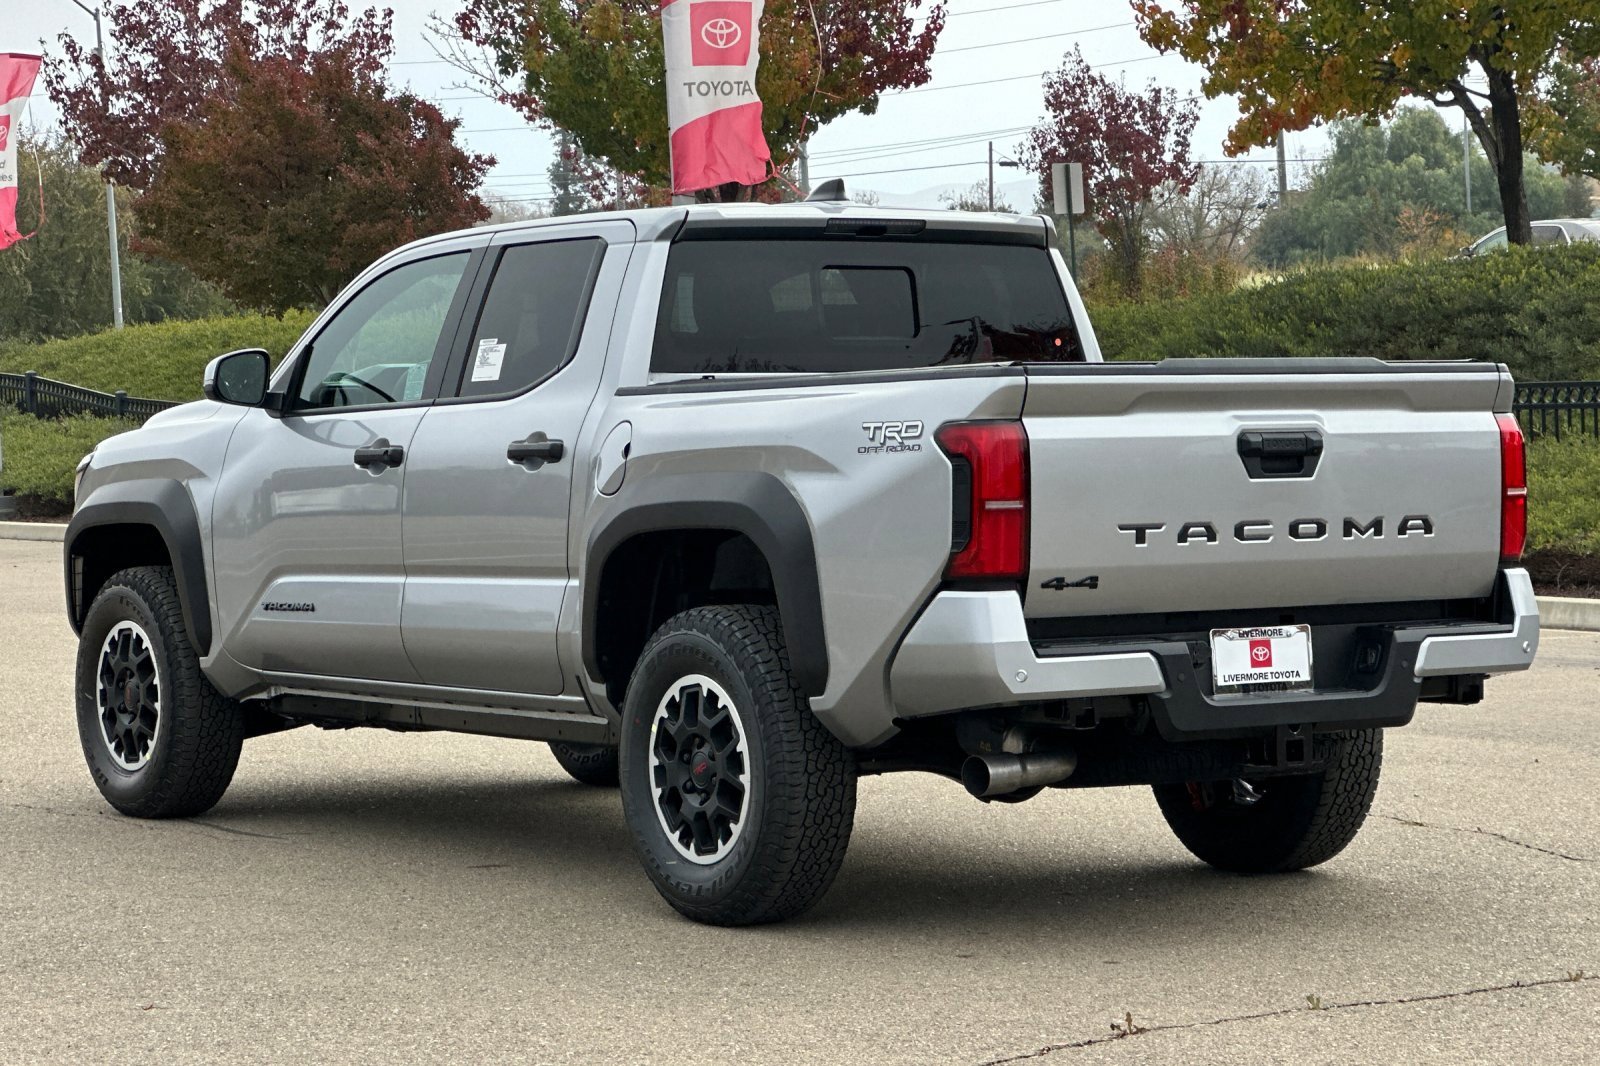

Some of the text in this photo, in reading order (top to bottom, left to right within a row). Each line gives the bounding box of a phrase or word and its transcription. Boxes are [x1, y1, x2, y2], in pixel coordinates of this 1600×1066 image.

[683, 80, 754, 98] TOYOTA
[862, 420, 924, 445] TRD
[886, 444, 922, 453] ROAD
[1117, 514, 1435, 548] TACOMA
[261, 602, 316, 612] TACOMA
[1238, 628, 1284, 638] LIVERMORE
[1223, 670, 1301, 683] LIVERMORE TOYOTA
